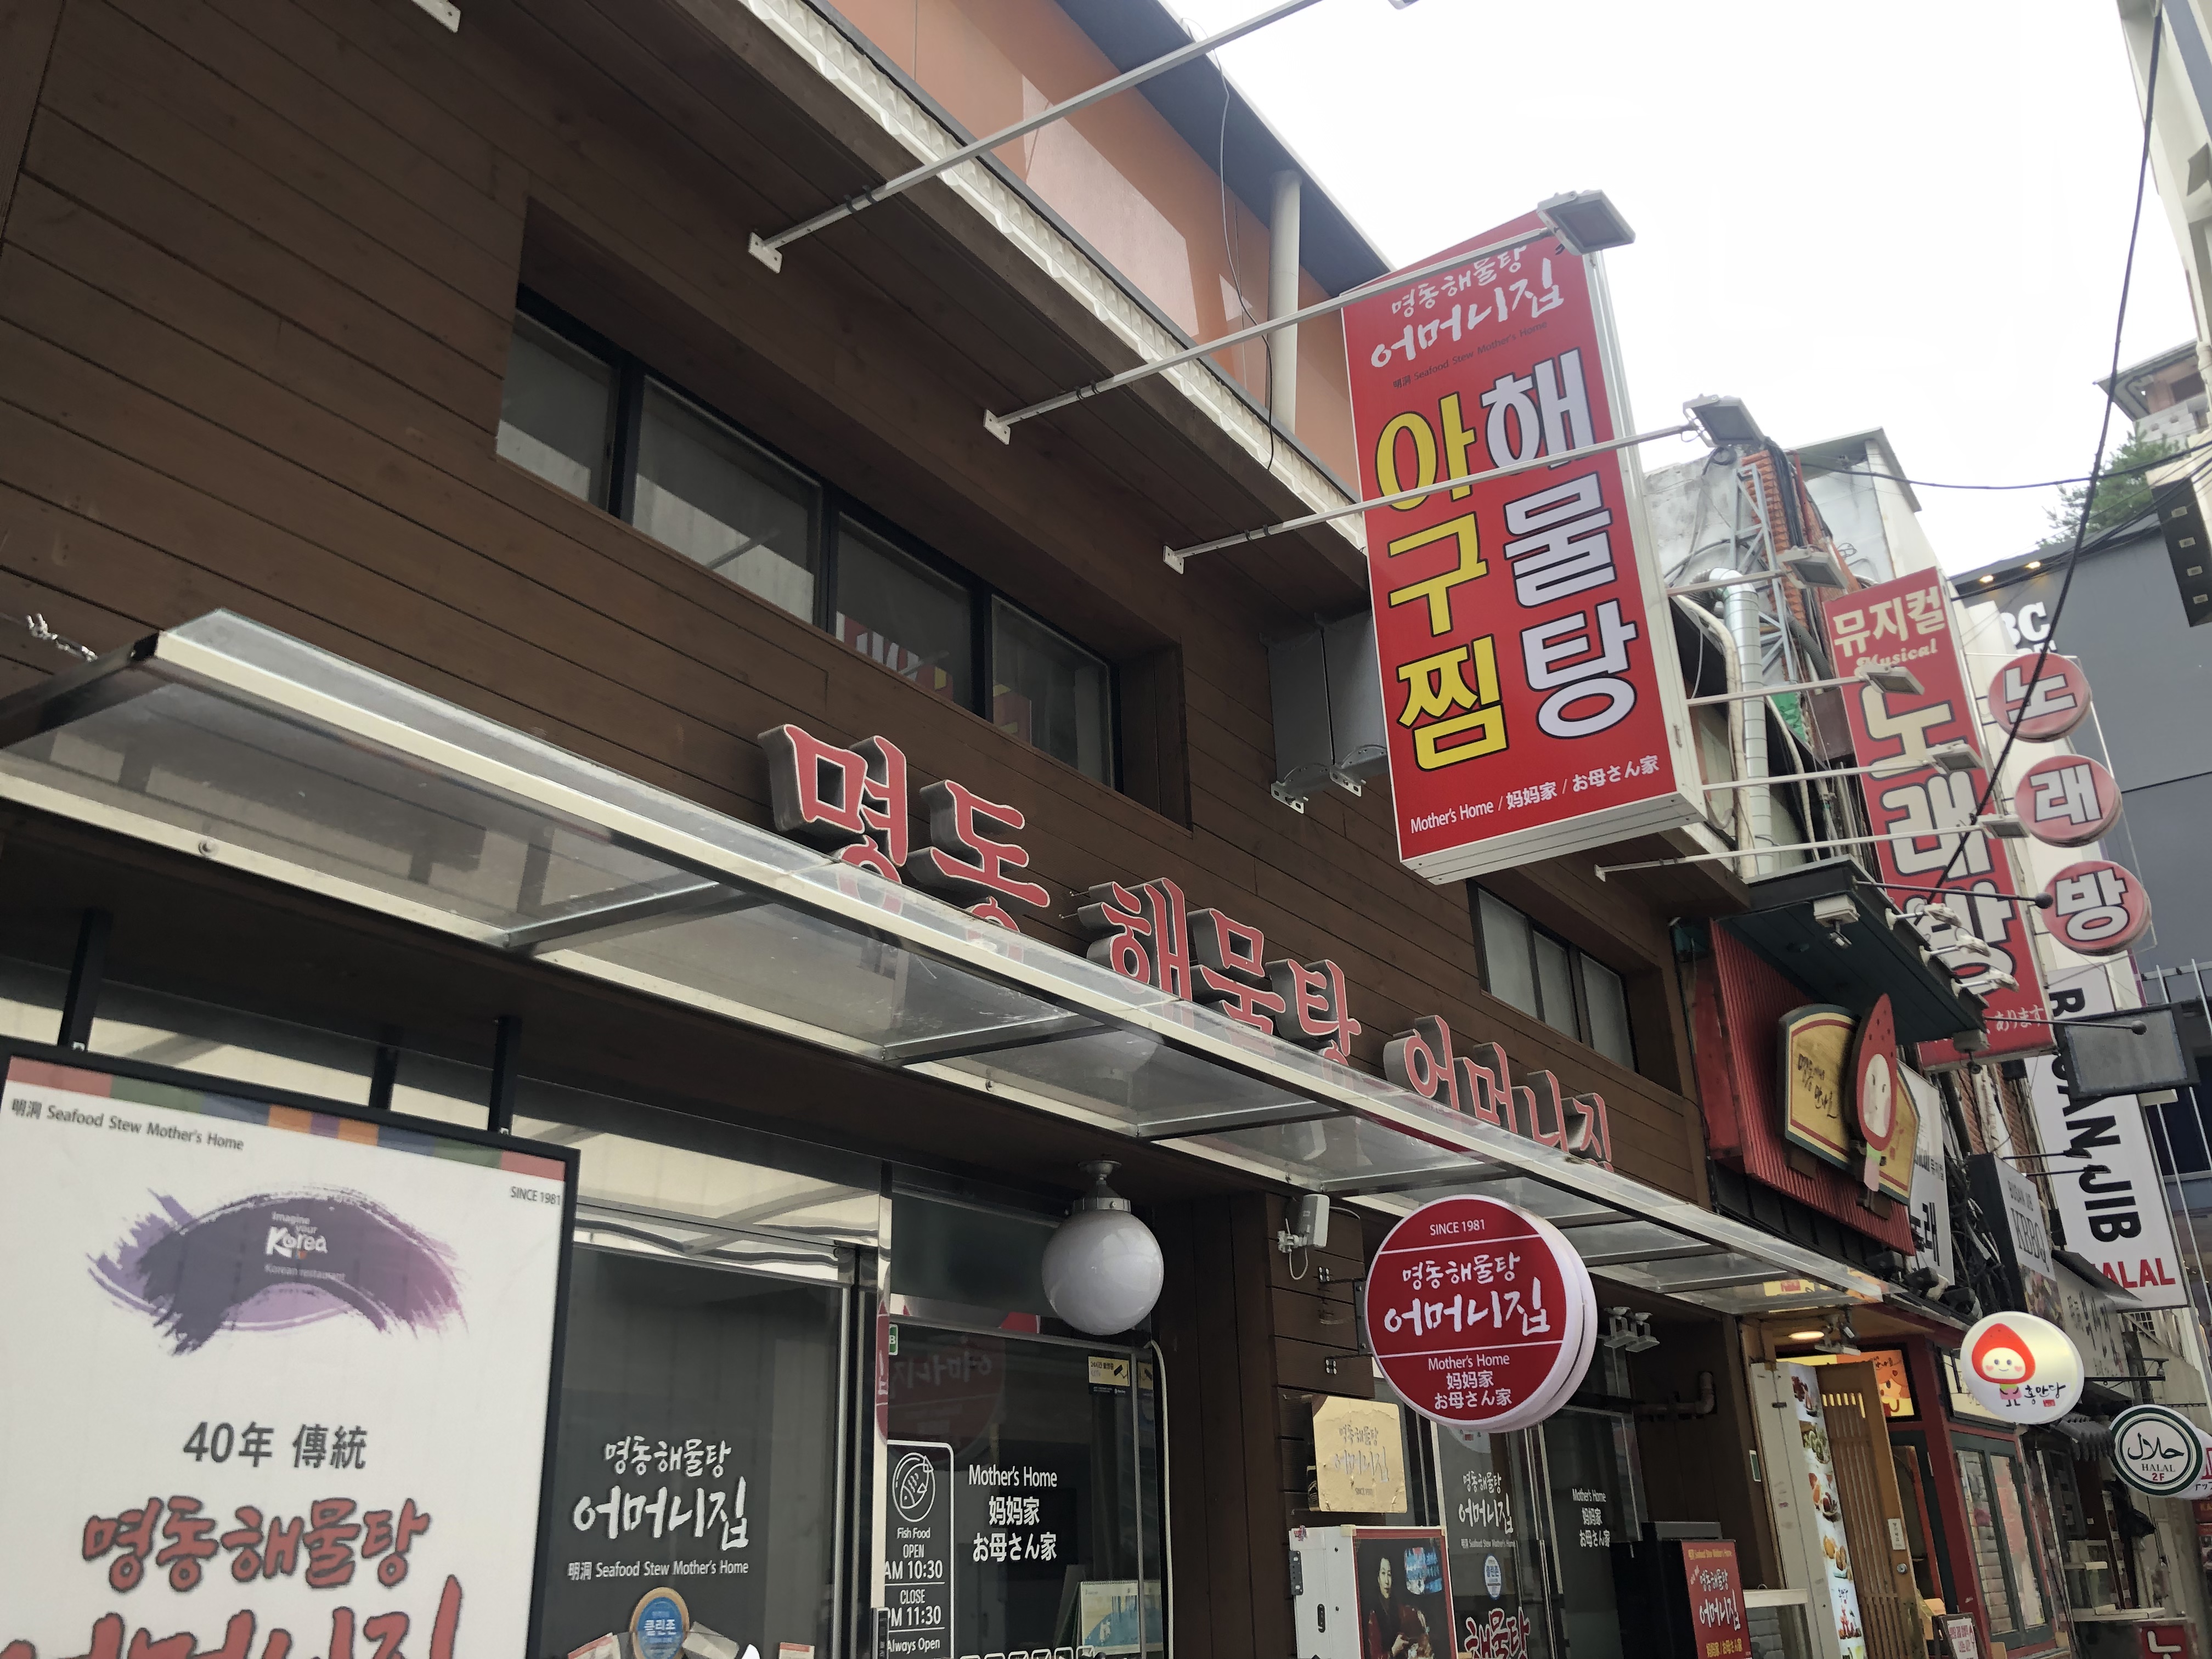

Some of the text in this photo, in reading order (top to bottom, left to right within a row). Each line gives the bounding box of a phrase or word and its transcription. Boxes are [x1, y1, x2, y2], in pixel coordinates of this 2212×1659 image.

[1392, 245, 1527, 317] 명동해물탕
[1371, 257, 1564, 368] 어머니집
[1414, 360, 1449, 380] Seafood
[1452, 350, 1474, 365] Stew
[1477, 334, 1517, 354] Mother's
[1519, 320, 1548, 337] Home
[1481, 346, 1639, 740] 해물탕
[1375, 392, 1509, 772] 아구찜
[1832, 585, 1946, 657] 뮤지컬
[1410, 808, 1457, 834] Mother's
[1459, 799, 1494, 821] Home
[1505, 781, 1558, 811] 妈妈家
[1571, 754, 1660, 793] お母さん家
[1860, 683, 2017, 997] 노래방
[47, 1104, 105, 1127] Seafood
[109, 1115, 143, 1134] Stew
[146, 1121, 202, 1144] Mother's
[206, 1132, 245, 1151] Home
[510, 1186, 561, 1206] SINCE 1981
[264, 1226, 329, 1259] Korea
[1430, 1219, 1486, 1237] SINCE 1981
[1402, 1251, 1521, 1290] 명동해물탕
[2092, 1257, 2176, 1289] ALAL
[1384, 1277, 1551, 1336] 어머니집
[1428, 1353, 1510, 1371] Mother's Home
[1446, 1370, 1494, 1390] 妈妈家
[1434, 1387, 1513, 1410] お母さん家
[183, 1421, 368, 1471] 40年 傳統
[605, 1435, 732, 1478] 명동해물탕
[2127, 1432, 2185, 1461] حلال
[968, 1464, 1058, 1488] Mother's Home
[2141, 1463, 2176, 1472] HALAL
[2152, 1472, 2165, 1481] 2F
[572, 1476, 749, 1550] 어머니집
[989, 1495, 1040, 1526] 妈妈家
[1458, 1492, 1514, 1534] 어머니집
[81, 1494, 431, 1593] 명동해물탕
[897, 1527, 931, 1539] Fish Food
[973, 1531, 1058, 1562] お母さん家
[902, 1543, 924, 1559] OPEN
[596, 1560, 641, 1578] Seafood
[644, 1561, 670, 1576] Stew
[673, 1559, 716, 1576] Mother's
[719, 1559, 749, 1575] Home
[885, 1559, 943, 1581] AM 10:30
[900, 1589, 926, 1605] CLOSE
[1699, 1588, 1741, 1631] 어머니집
[906, 1605, 941, 1626] 11:30
[887, 1637, 941, 1655] Always Open
